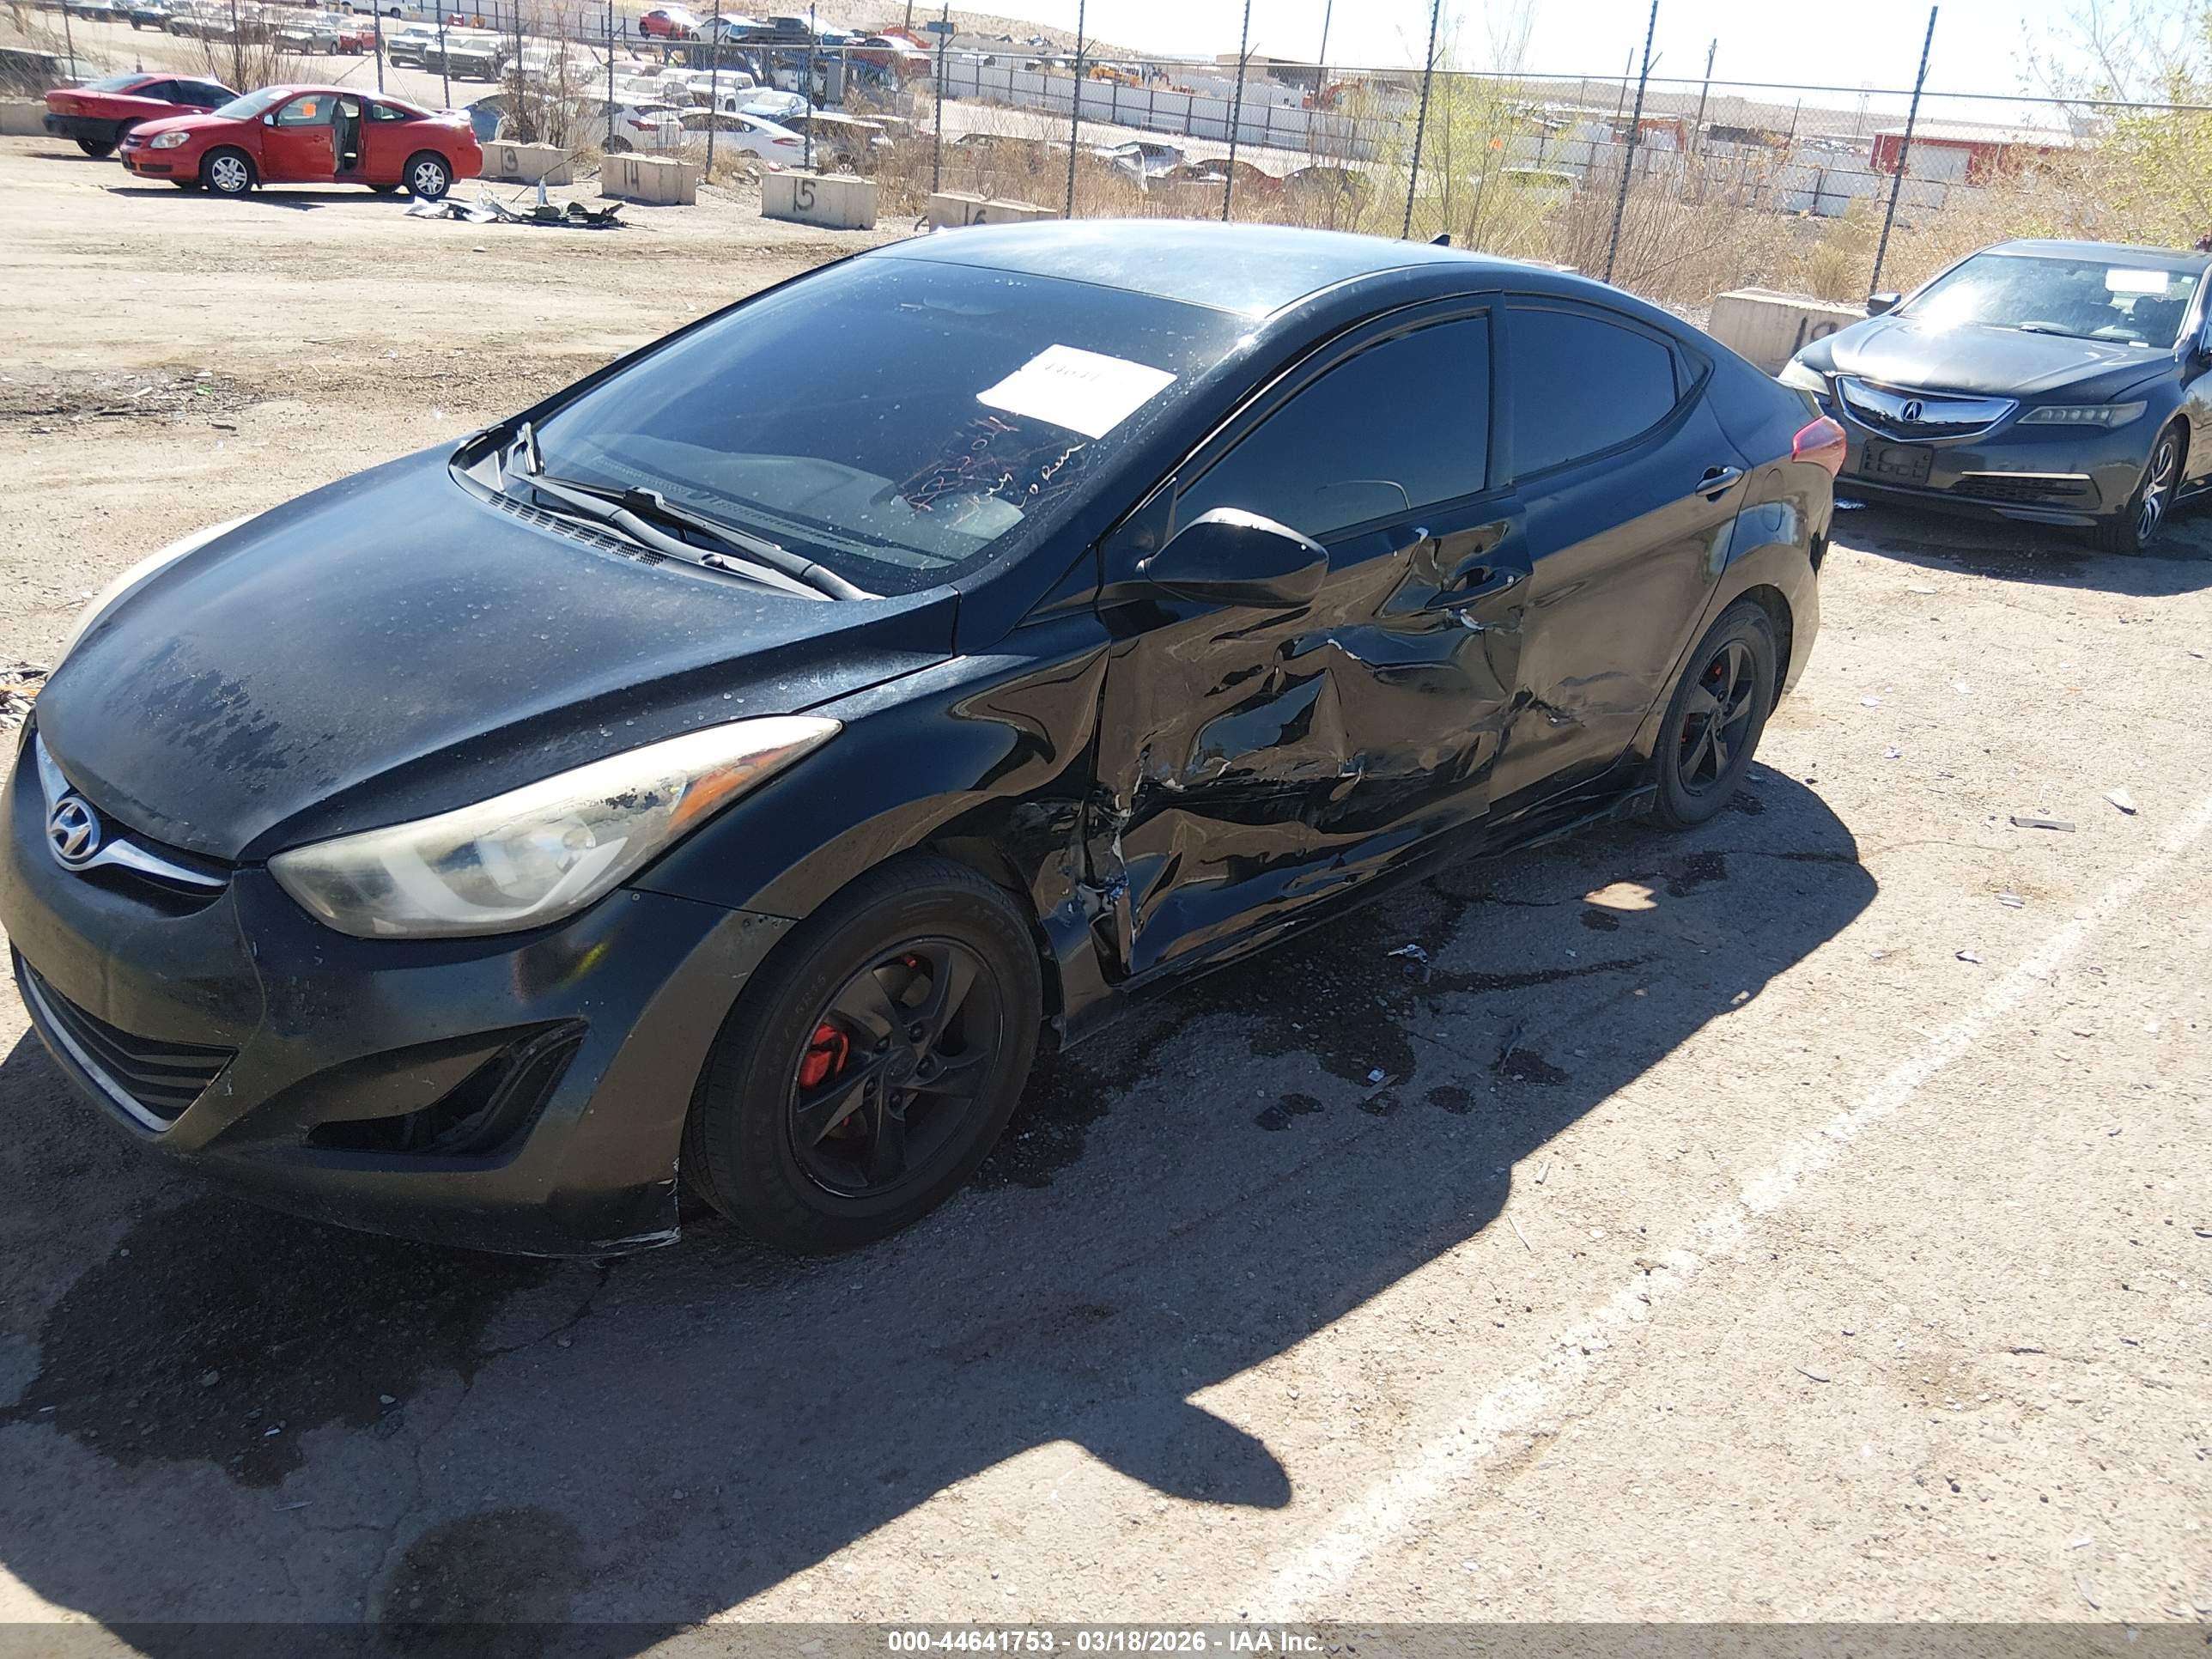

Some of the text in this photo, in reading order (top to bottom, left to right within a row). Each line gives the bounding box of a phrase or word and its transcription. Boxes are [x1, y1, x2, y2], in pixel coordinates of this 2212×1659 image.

[500, 146, 519, 173] 13
[623, 159, 640, 191] 14
[793, 177, 816, 213] 15
